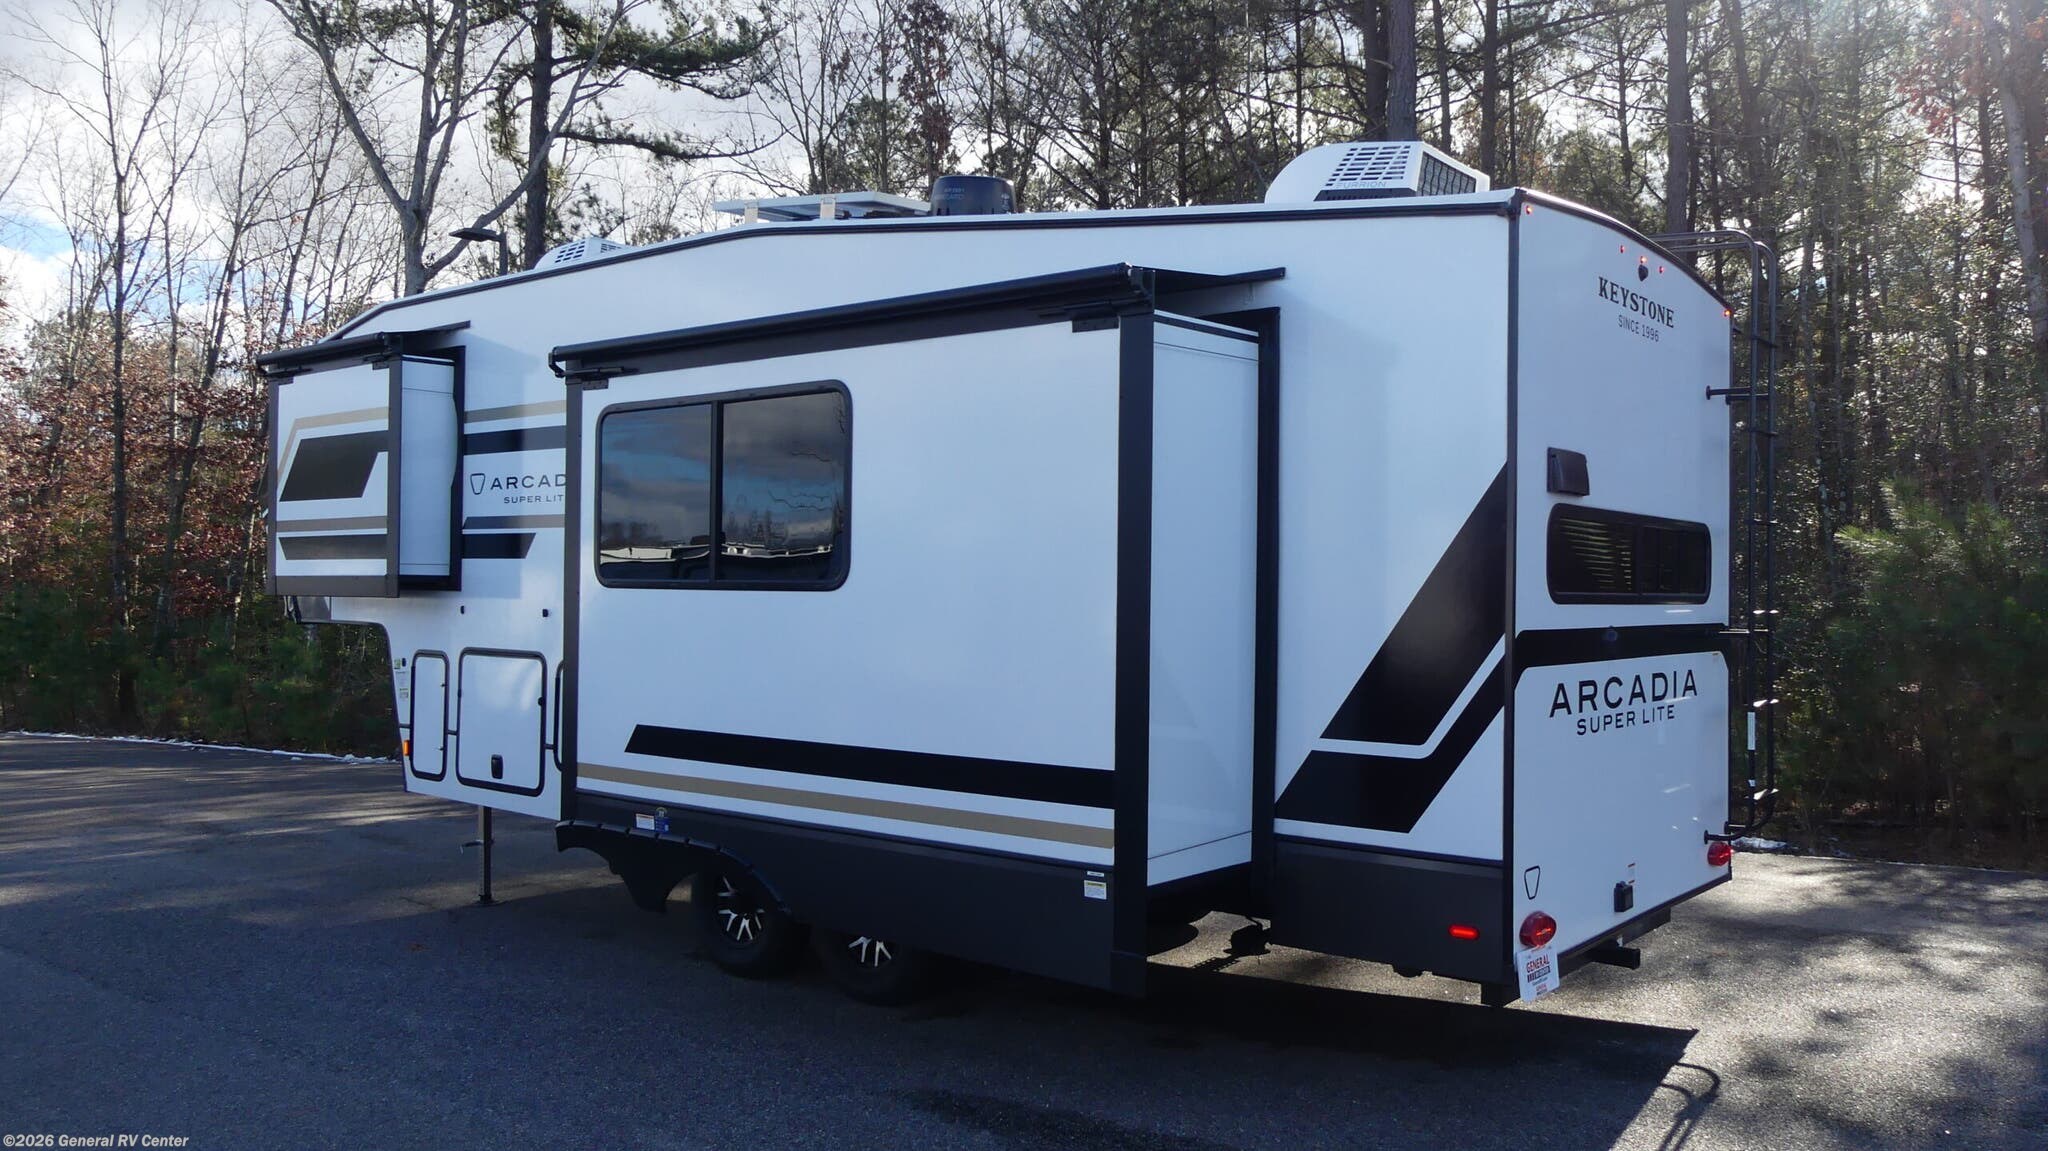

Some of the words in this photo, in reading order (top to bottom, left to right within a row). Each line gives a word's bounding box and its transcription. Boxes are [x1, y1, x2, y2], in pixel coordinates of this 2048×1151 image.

[1598, 276, 1675, 328] KEYSTONE
[1618, 314, 1640, 335] SINCE
[1642, 324, 1659, 342] 1996
[490, 473, 566, 490] ARCAD
[503, 495, 541, 504] SUPER
[545, 494, 564, 502] LIT
[1549, 669, 1698, 718] ARCADIA
[1576, 710, 1636, 736] SUPER
[1642, 704, 1675, 724] LITE
